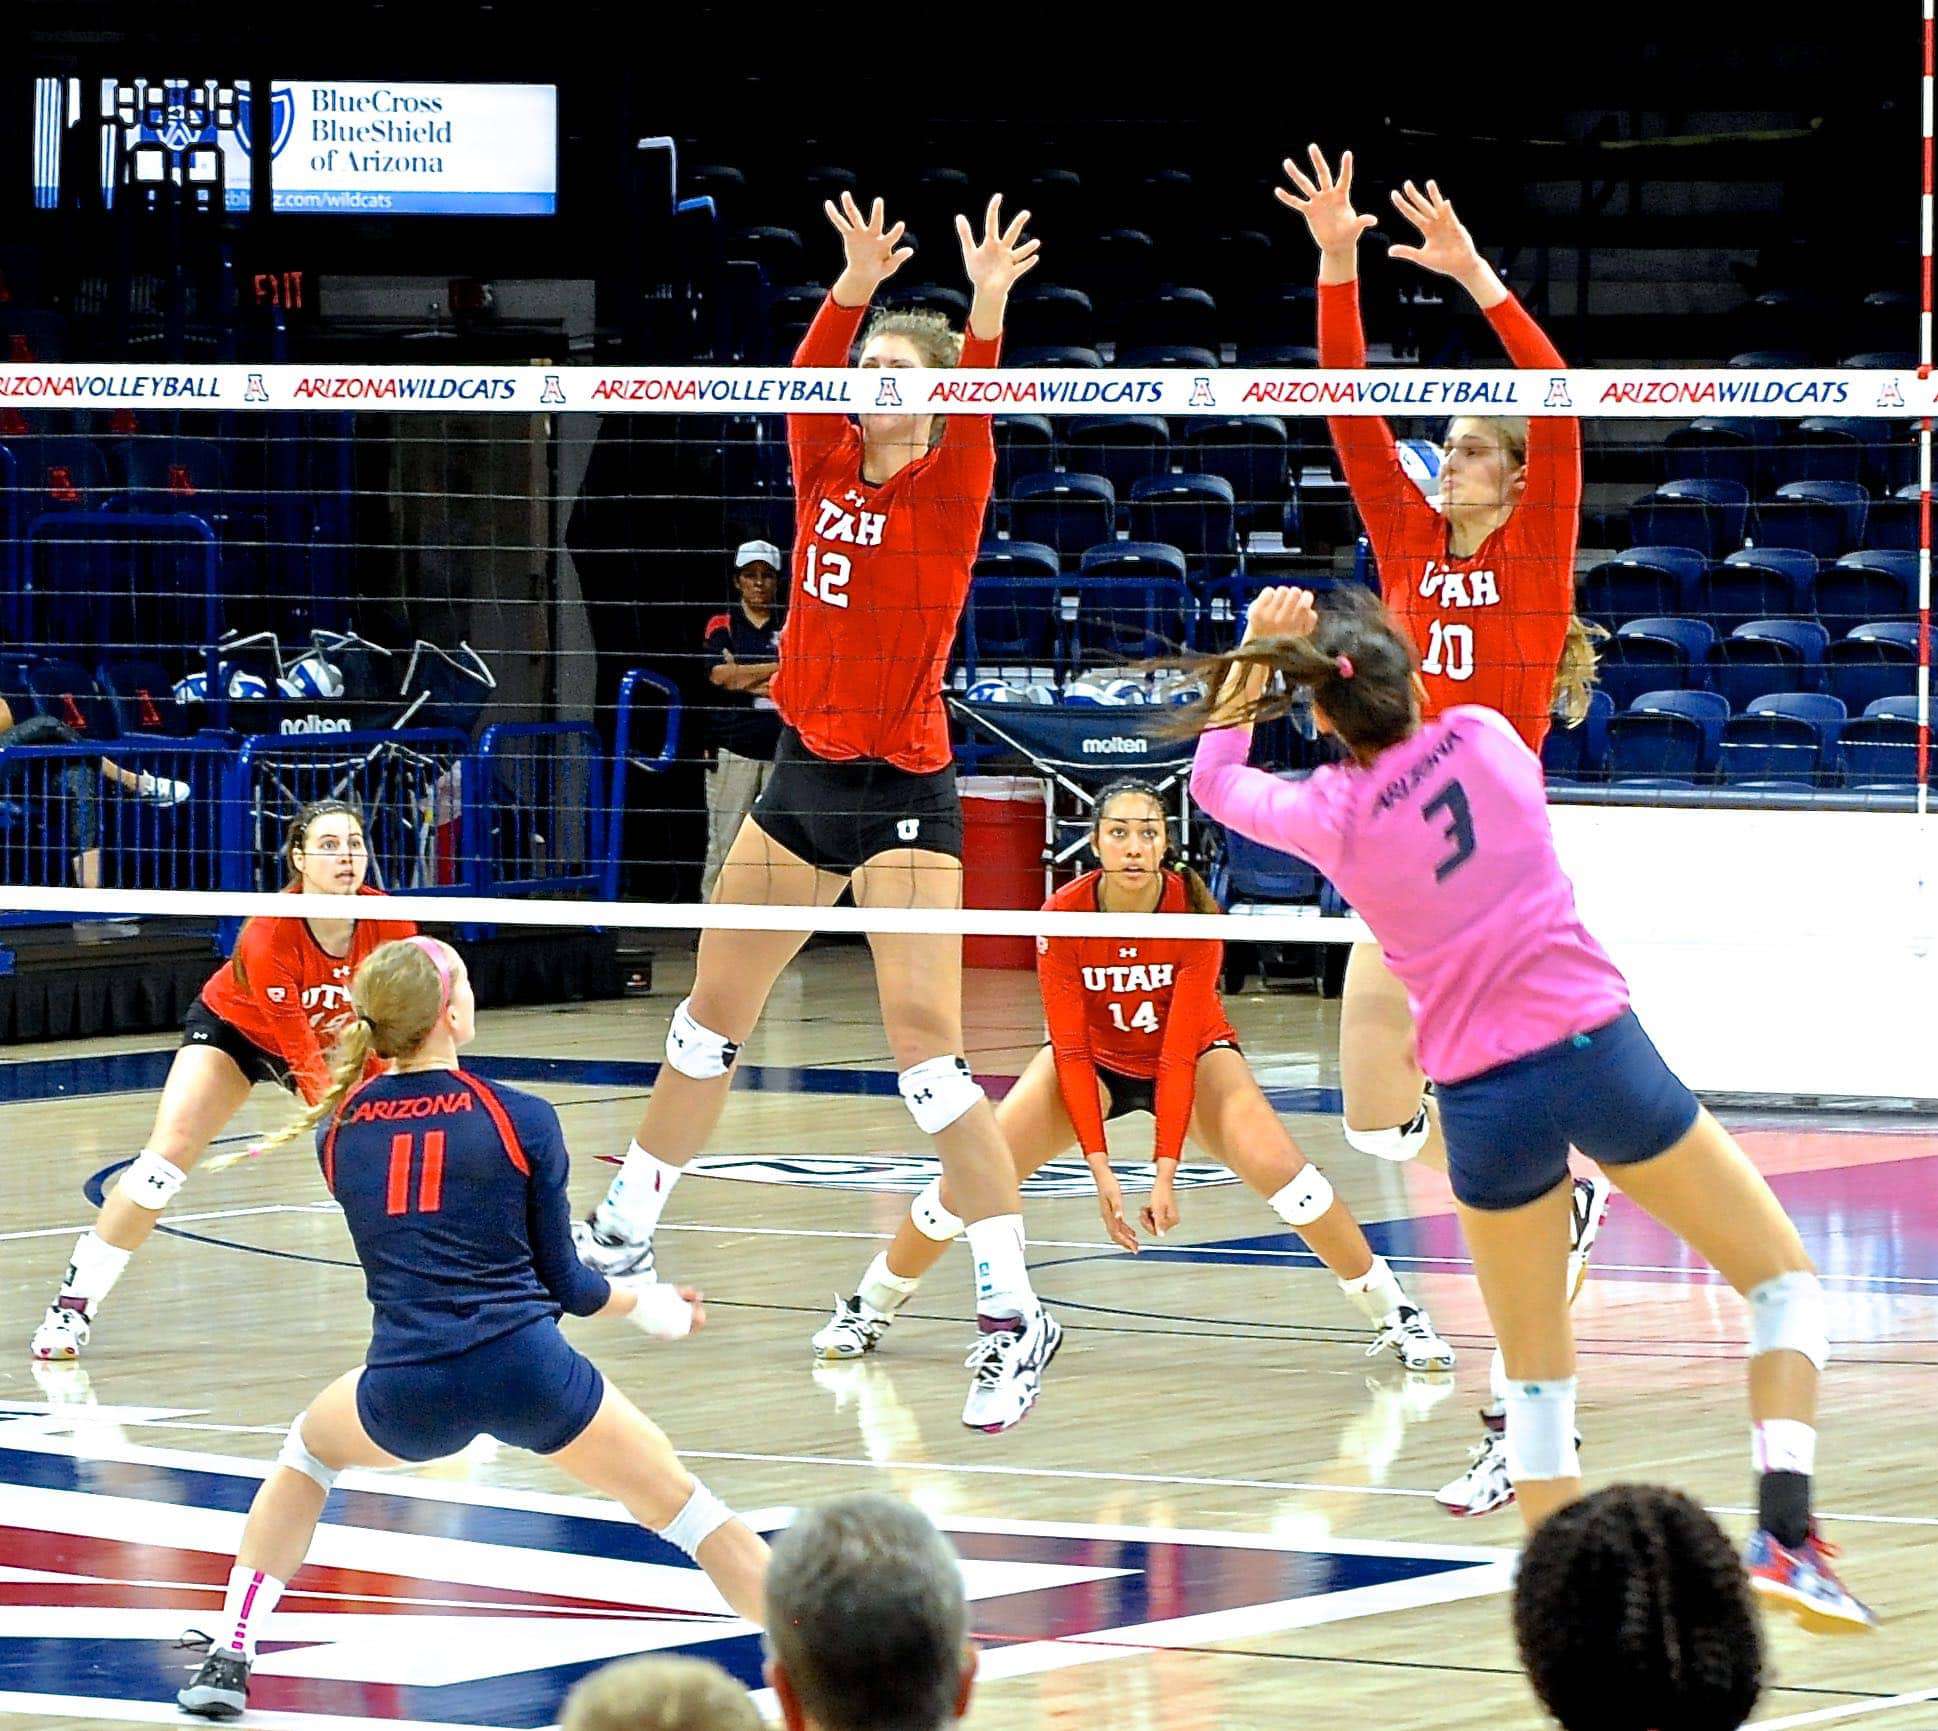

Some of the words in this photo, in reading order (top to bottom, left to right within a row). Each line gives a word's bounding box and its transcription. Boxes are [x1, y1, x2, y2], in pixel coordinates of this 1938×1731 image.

[311, 88, 443, 113] BlueCross
[311, 119, 453, 144] BlueShield
[310, 149, 339, 172] of
[344, 150, 444, 173] Arizona
[0, 376, 221, 397] IZONAVOLLEYBALL
[814, 498, 887, 547] TAH
[802, 543, 852, 609] 12
[1421, 618, 1474, 681] 10
[1082, 736, 1148, 754] molten
[1421, 777, 1477, 886] 3
[1081, 963, 1174, 993] UTAH
[1107, 1000, 1160, 1034] 14
[351, 1091, 474, 1123] ARIZONA
[386, 1128, 446, 1216] 11
